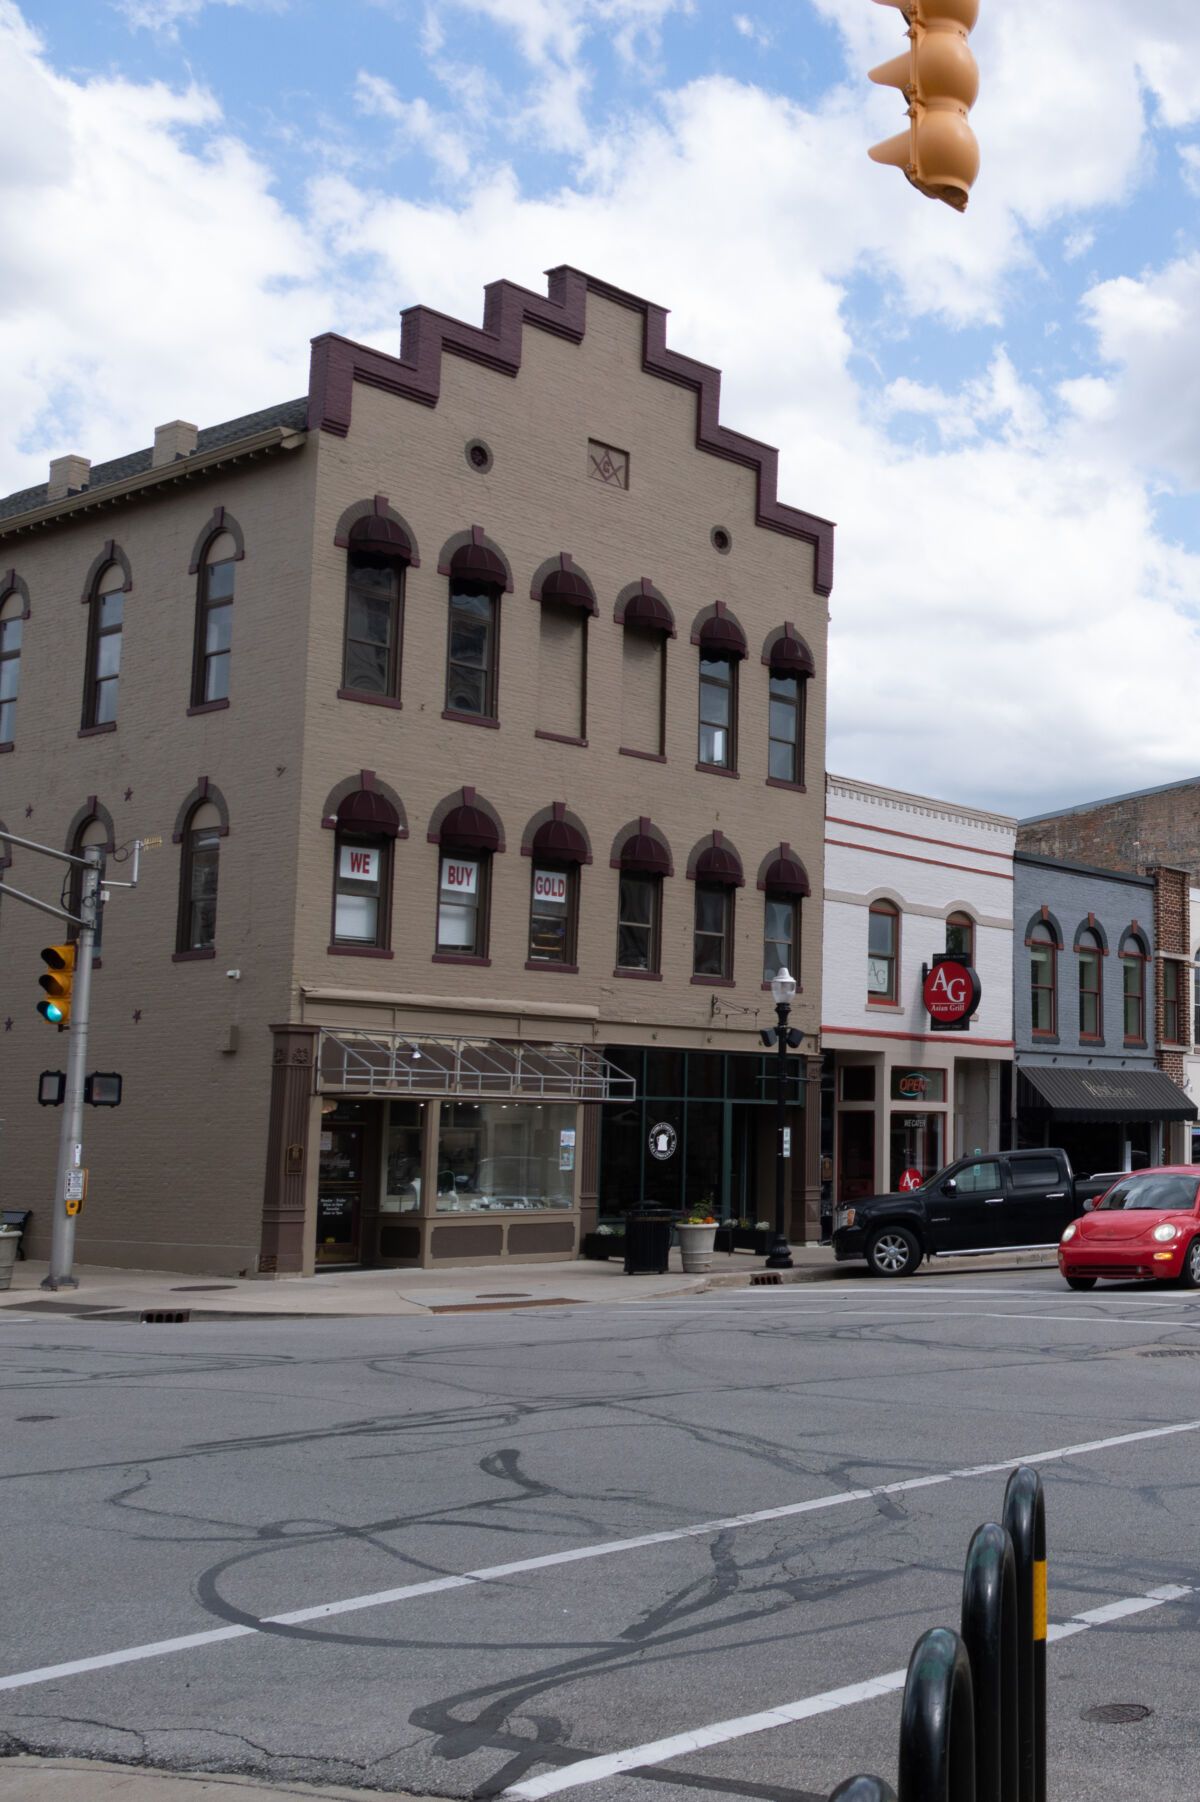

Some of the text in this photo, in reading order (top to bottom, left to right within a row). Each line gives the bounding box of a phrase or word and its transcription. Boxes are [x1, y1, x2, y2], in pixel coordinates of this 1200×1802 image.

[603, 460, 610, 474] G
[350, 851, 370, 874] WE
[447, 865, 474, 887] BUY
[535, 876, 566, 898] GOLD
[869, 961, 886, 985] AG
[930, 967, 967, 1003] AG
[931, 1003, 965, 1012] Asian Grill
[900, 1078, 927, 1091] OPEN
[904, 1119, 926, 1128] WE CATER
